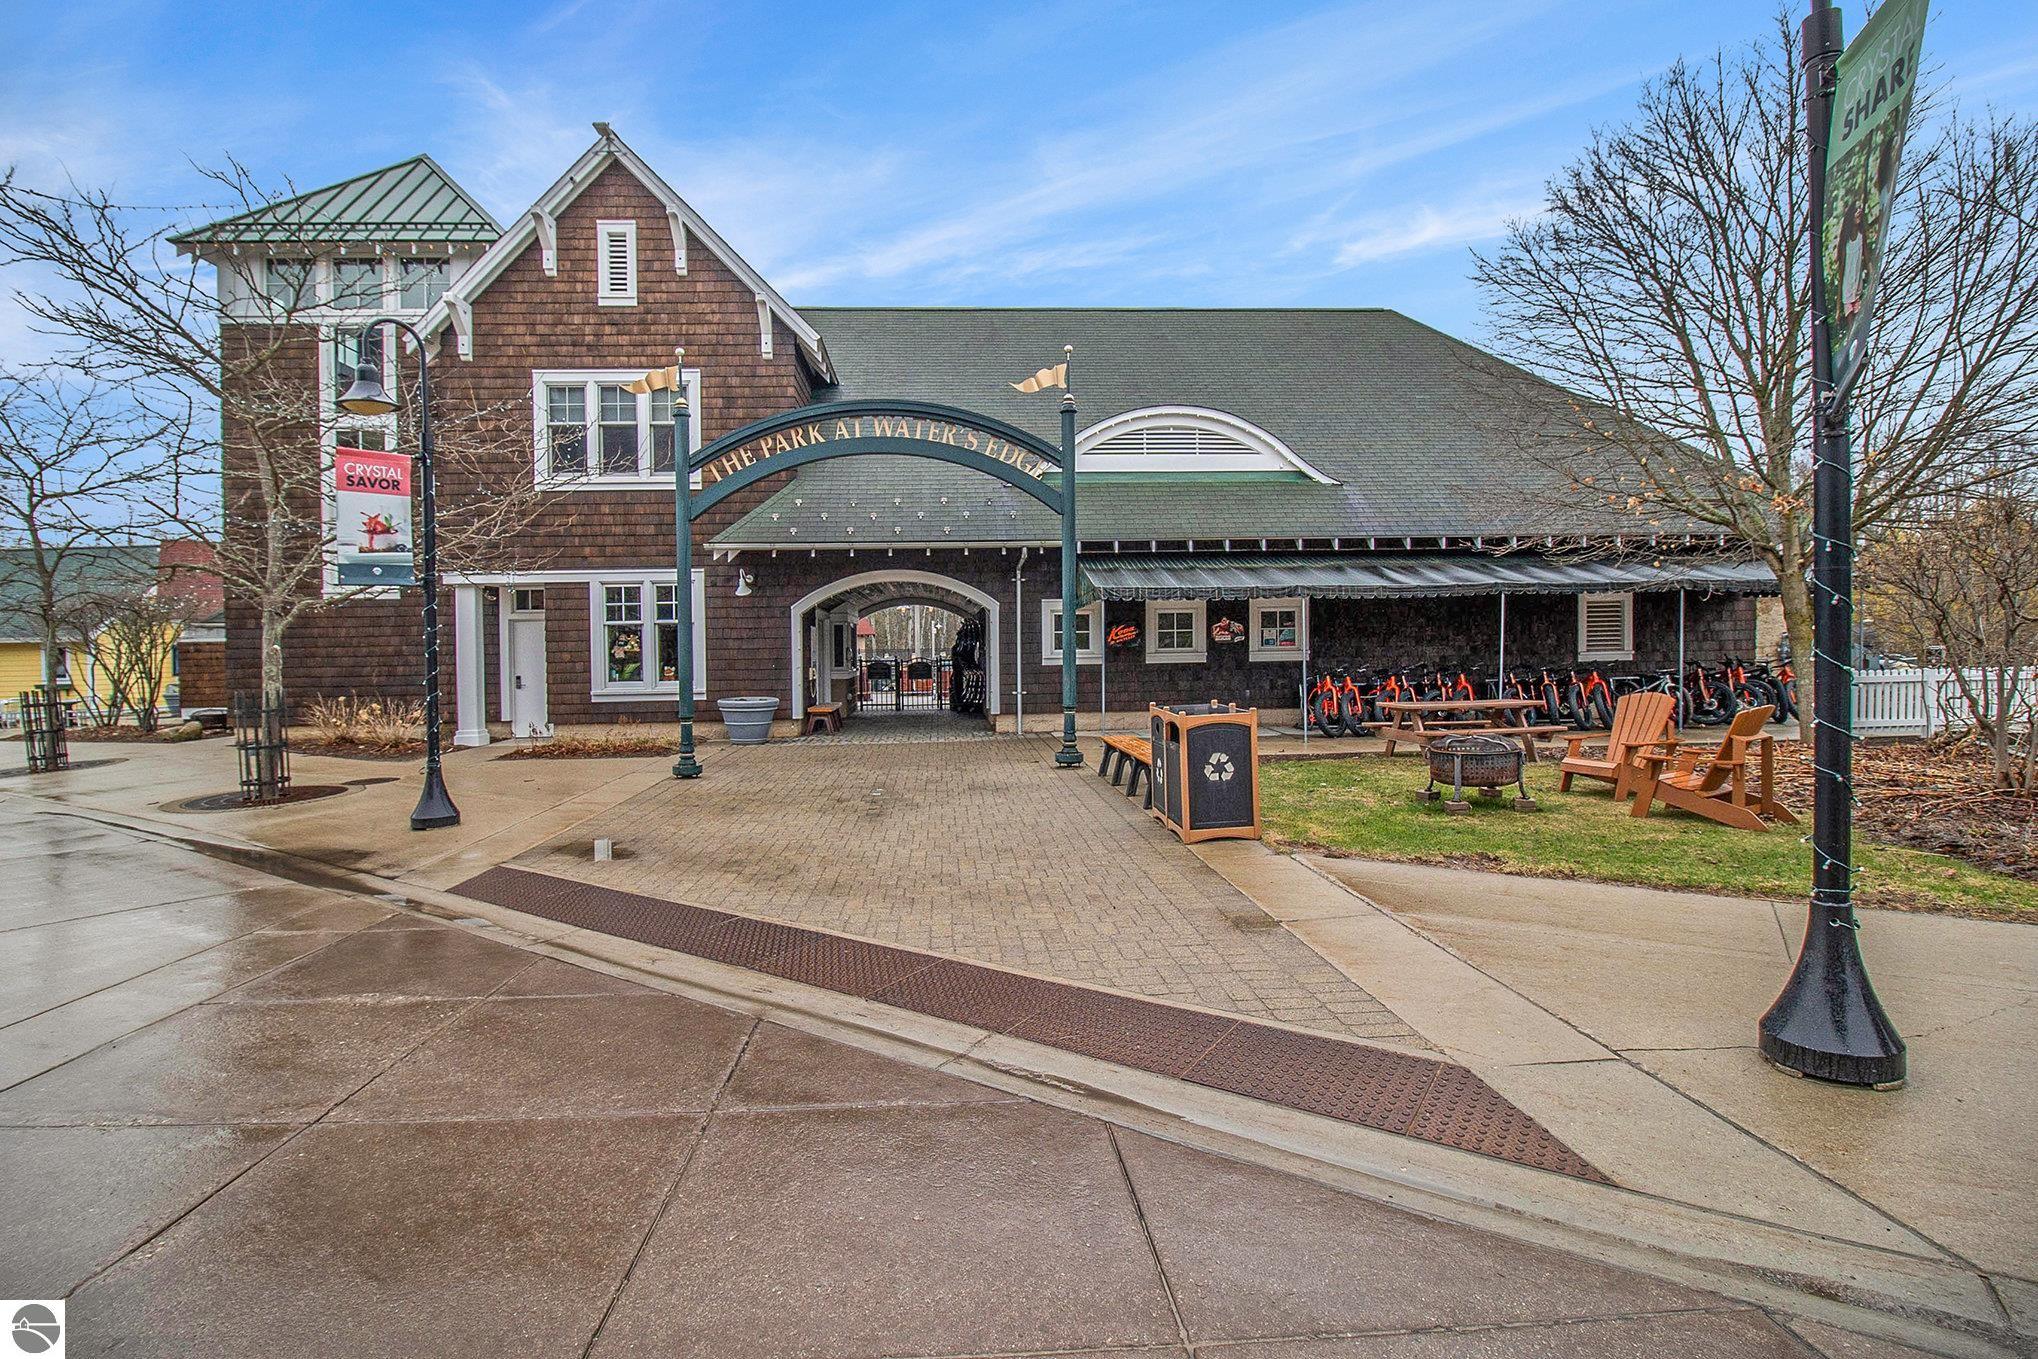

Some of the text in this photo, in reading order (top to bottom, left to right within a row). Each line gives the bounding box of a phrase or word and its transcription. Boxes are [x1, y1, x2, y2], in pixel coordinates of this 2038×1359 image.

[708, 416, 1051, 482] THE PARK AT WATER'S EDGE
[343, 462, 404, 480] CRYSTAL
[346, 475, 401, 490] SAVOR
